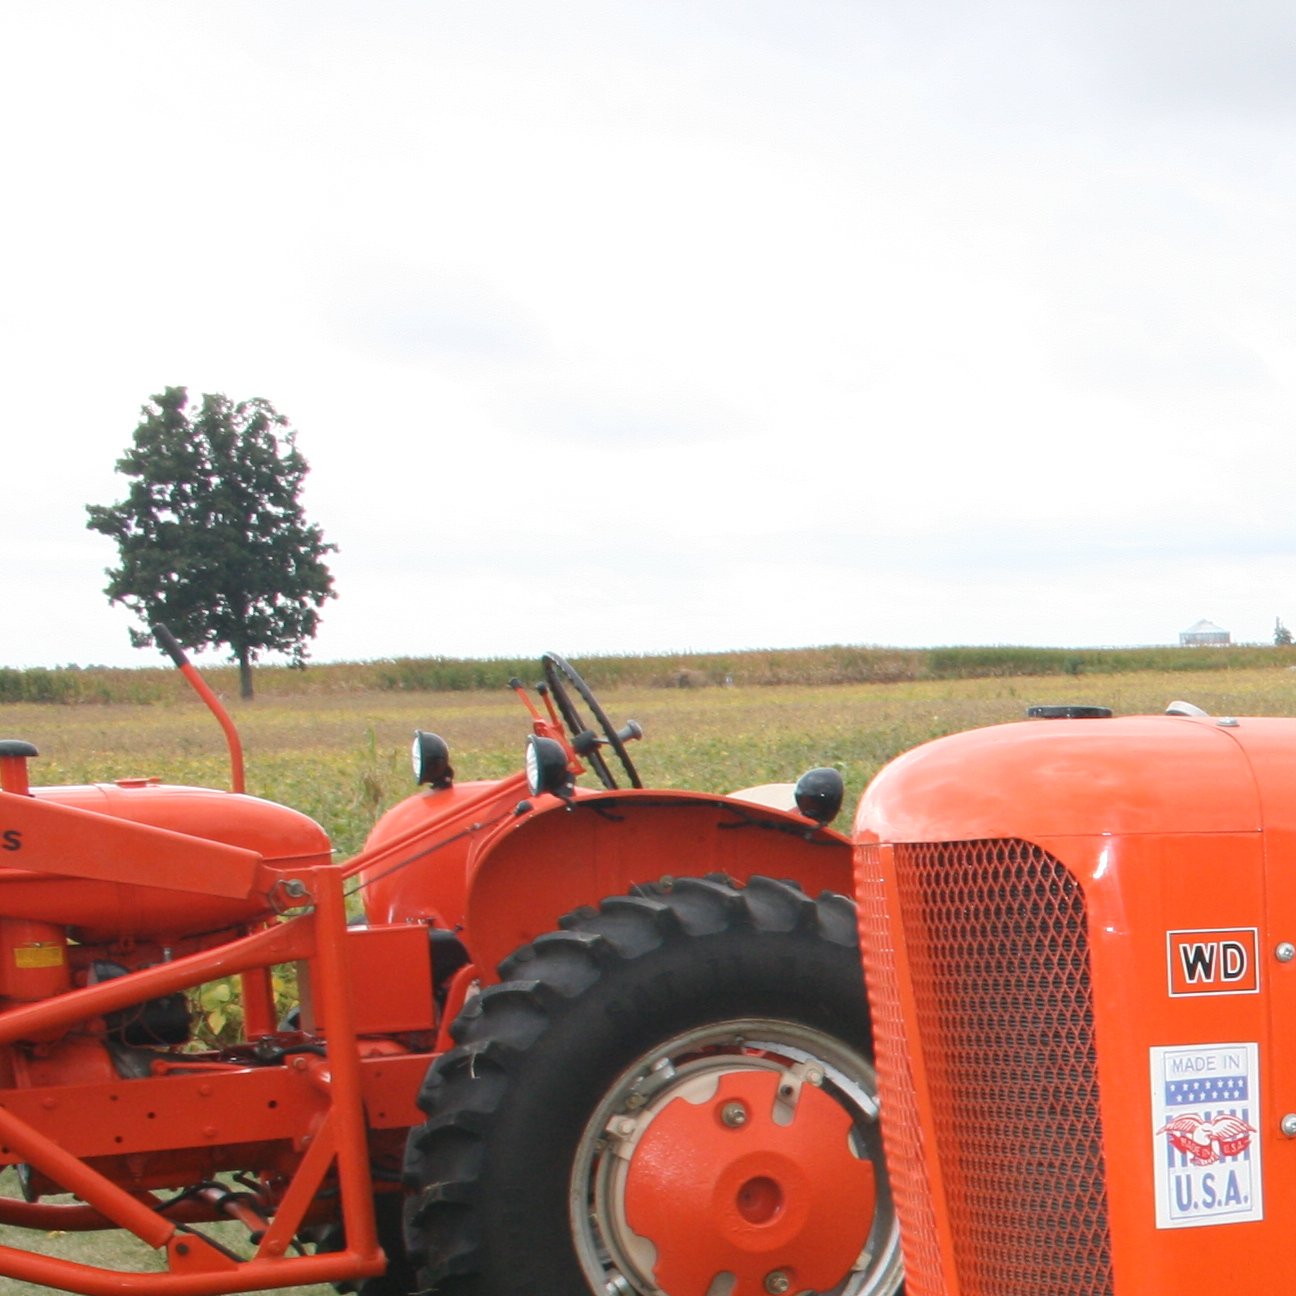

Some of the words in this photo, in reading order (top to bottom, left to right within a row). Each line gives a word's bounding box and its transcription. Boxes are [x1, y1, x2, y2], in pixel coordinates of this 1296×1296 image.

[1179, 941, 1248, 983] WD
[1171, 1056, 1217, 1074] MADE
[1223, 1054, 1240, 1070] IN
[1174, 1169, 1249, 1212] U.S.A.
